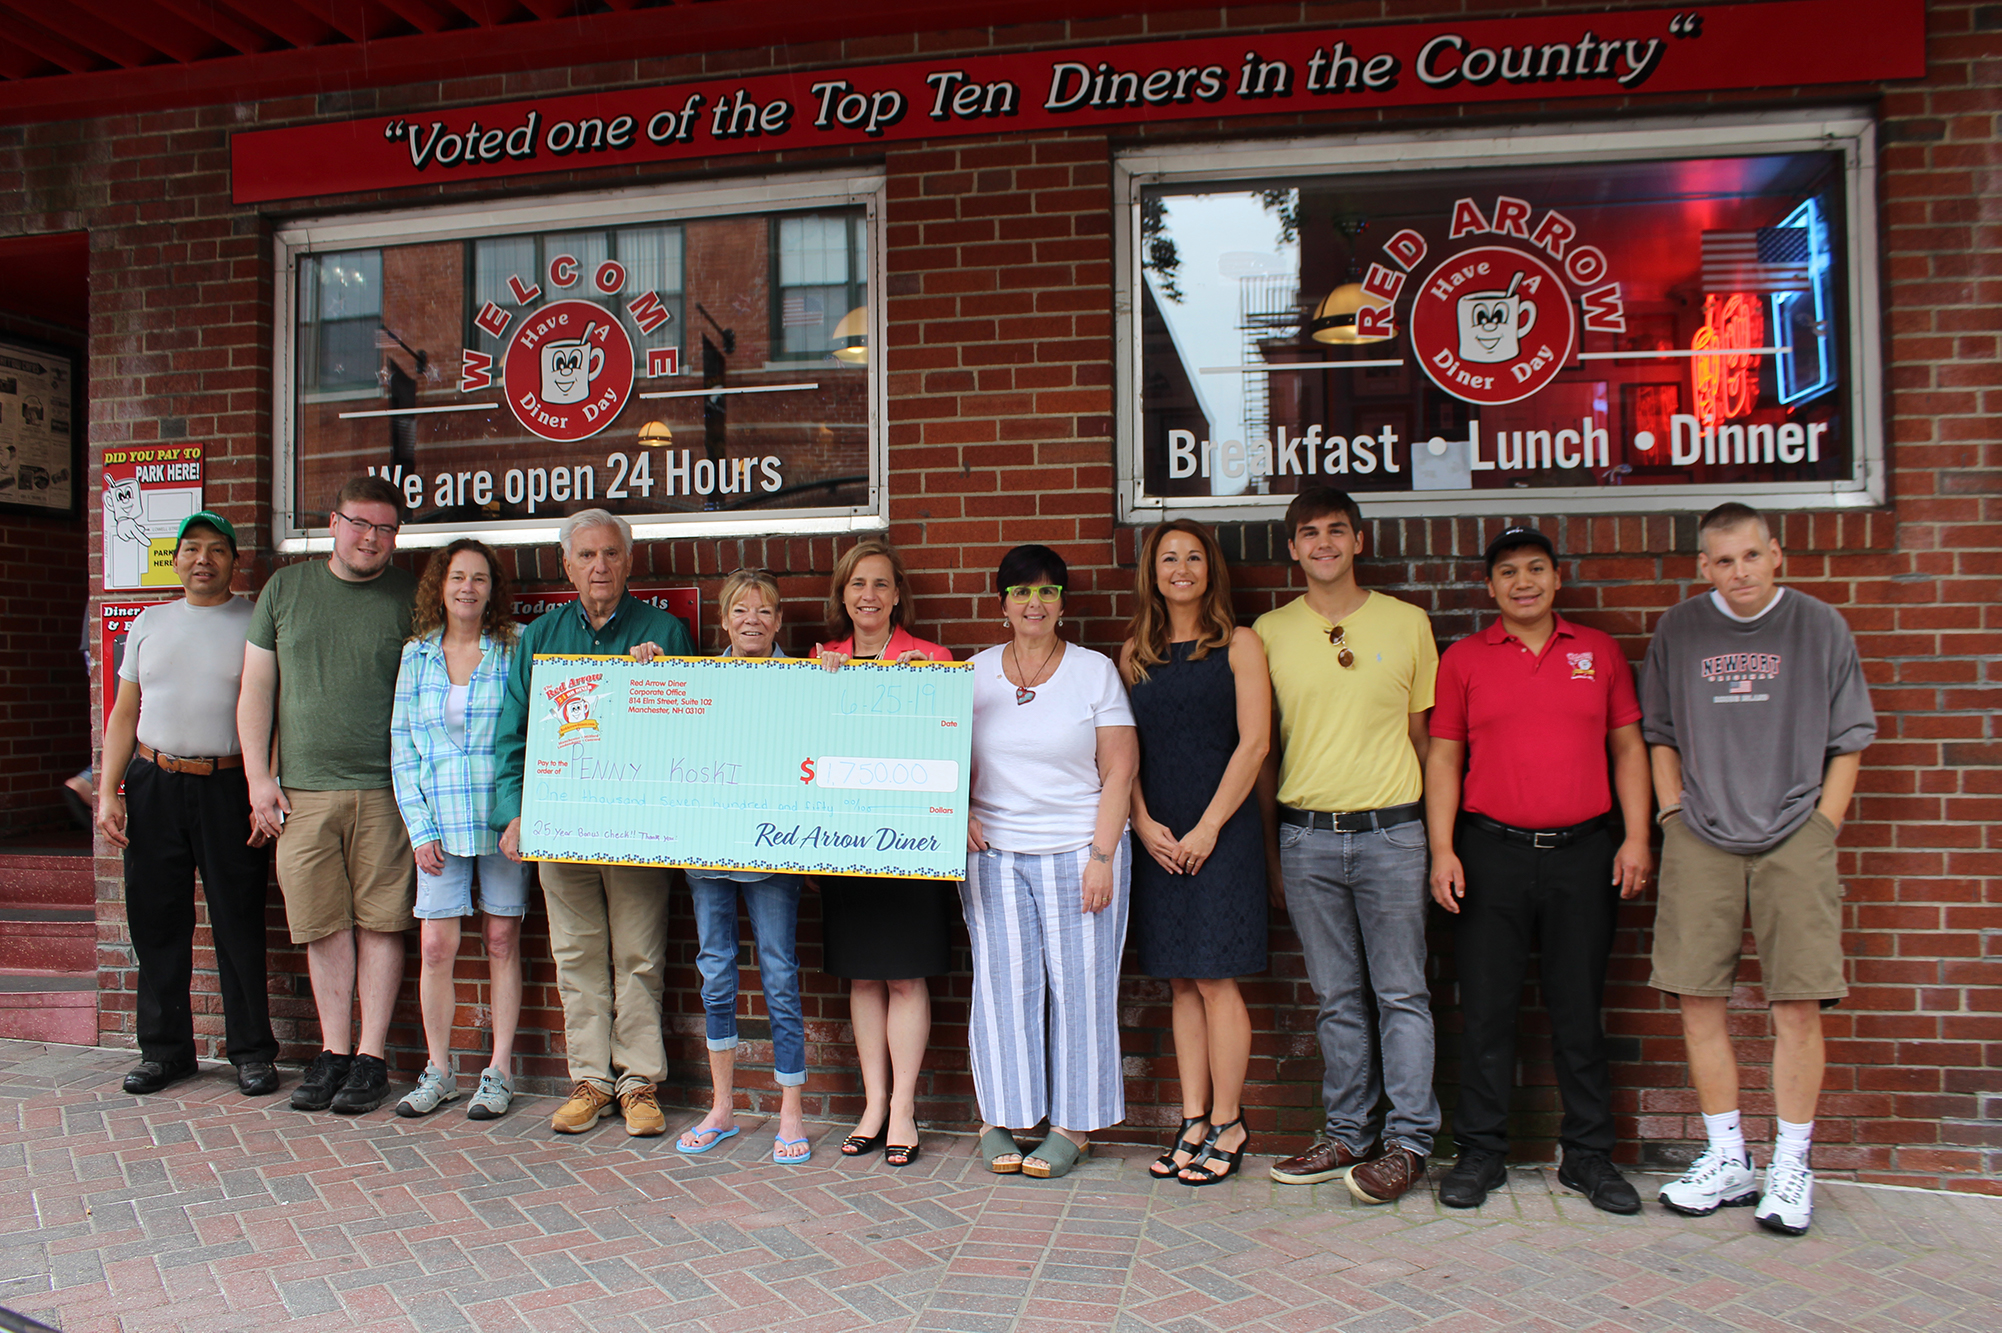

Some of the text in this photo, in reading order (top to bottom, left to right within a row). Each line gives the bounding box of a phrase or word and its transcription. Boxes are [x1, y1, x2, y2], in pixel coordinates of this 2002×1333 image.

[546, 109, 637, 152] one
[647, 94, 701, 140] of
[710, 89, 790, 137] the
[811, 80, 905, 133] Top
[925, 70, 1015, 118] Ten
[1044, 60, 1223, 109] Diners
[1236, 51, 1289, 96] in
[1306, 42, 1396, 91] the
[1356, 195, 1626, 339] RED ARROW
[1430, 261, 1543, 301] Have A
[460, 253, 679, 393] WELCOME
[520, 312, 611, 350] Have A
[1431, 343, 1555, 392] Diner Day
[518, 386, 618, 429] Diner Day
[104, 447, 201, 464] DID YOU PAY TO
[1167, 412, 1828, 479] Breakfast Lunch Dinner
[135, 462, 200, 483] PARK HERE!
[434, 469, 493, 508] are
[504, 464, 594, 513] open
[606, 451, 653, 499] 24
[666, 449, 783, 496] Hours
[103, 606, 140, 617] Diner
[108, 621, 120, 631] &
[1701, 653, 1781, 677] NEWPORT
[545, 673, 603, 700] Red Arrow
[629, 688, 686, 698] Corporate Office
[630, 679, 687, 688] Red Arrow Diner
[628, 706, 705, 715] Manchester, NH 03101
[657, 698, 679, 707] Street,
[681, 698, 699, 706] Suite
[941, 720, 958, 728] Date
[537, 760, 551, 769] Pay
[551, 760, 559, 768] to
[571, 743, 642, 782] PENNY
[800, 757, 815, 785] $
[536, 782, 568, 801] One
[581, 790, 646, 806] thousand
[712, 797, 768, 811] hundred
[777, 801, 798, 812] and
[805, 800, 834, 817] fifty
[533, 820, 551, 836] 25
[755, 822, 941, 851] Red Arrow Diner
